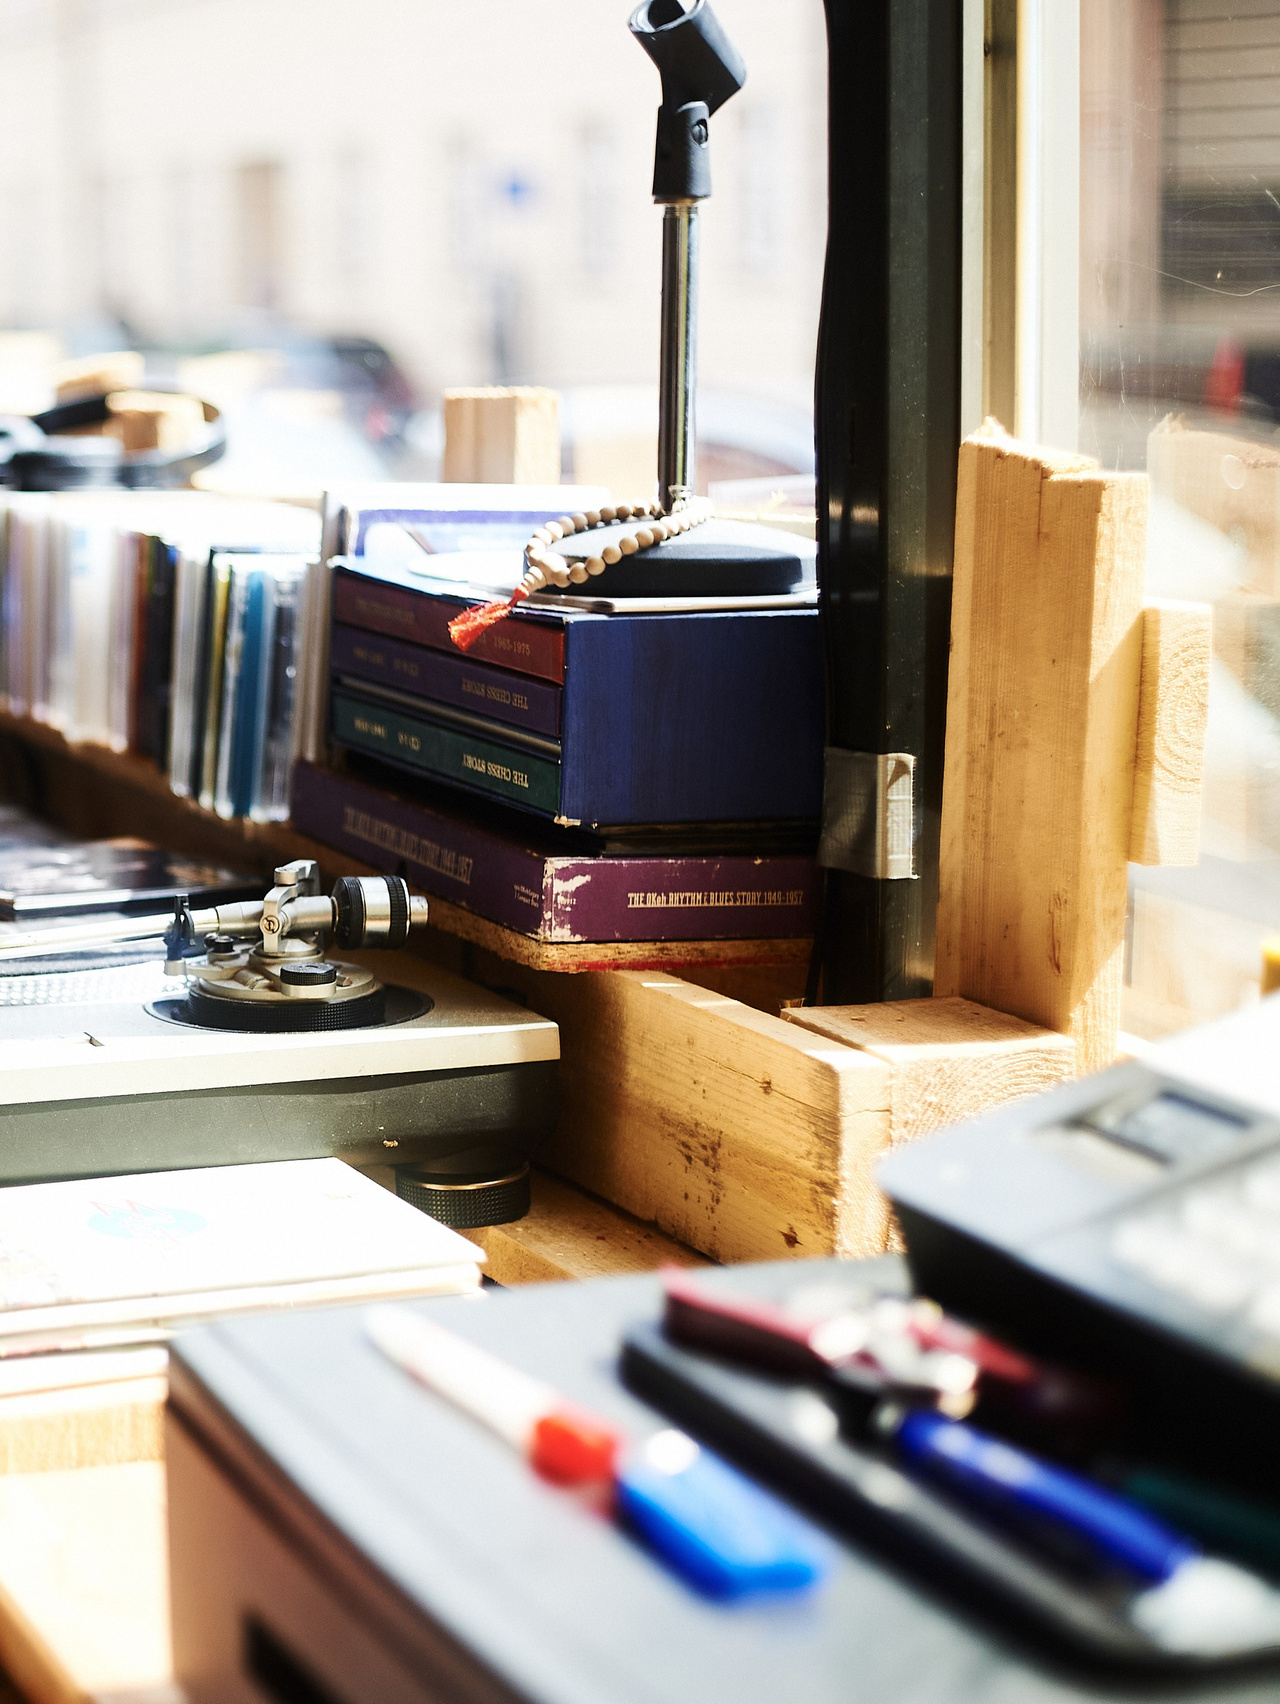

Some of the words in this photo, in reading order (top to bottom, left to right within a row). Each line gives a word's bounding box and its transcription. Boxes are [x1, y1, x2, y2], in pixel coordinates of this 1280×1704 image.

[487, 686, 511, 705] CHESS
[512, 693, 529, 710] THE
[462, 754, 486, 774] STORY
[487, 761, 511, 782] CHESS
[512, 770, 529, 789] THE
[627, 892, 645, 908] THE
[646, 892, 667, 908] OKeh
[668, 892, 703, 907] RHYTHM
[709, 891, 734, 906] BLUES
[736, 891, 761, 906] STORY
[764, 890, 804, 906] 1949-1957
